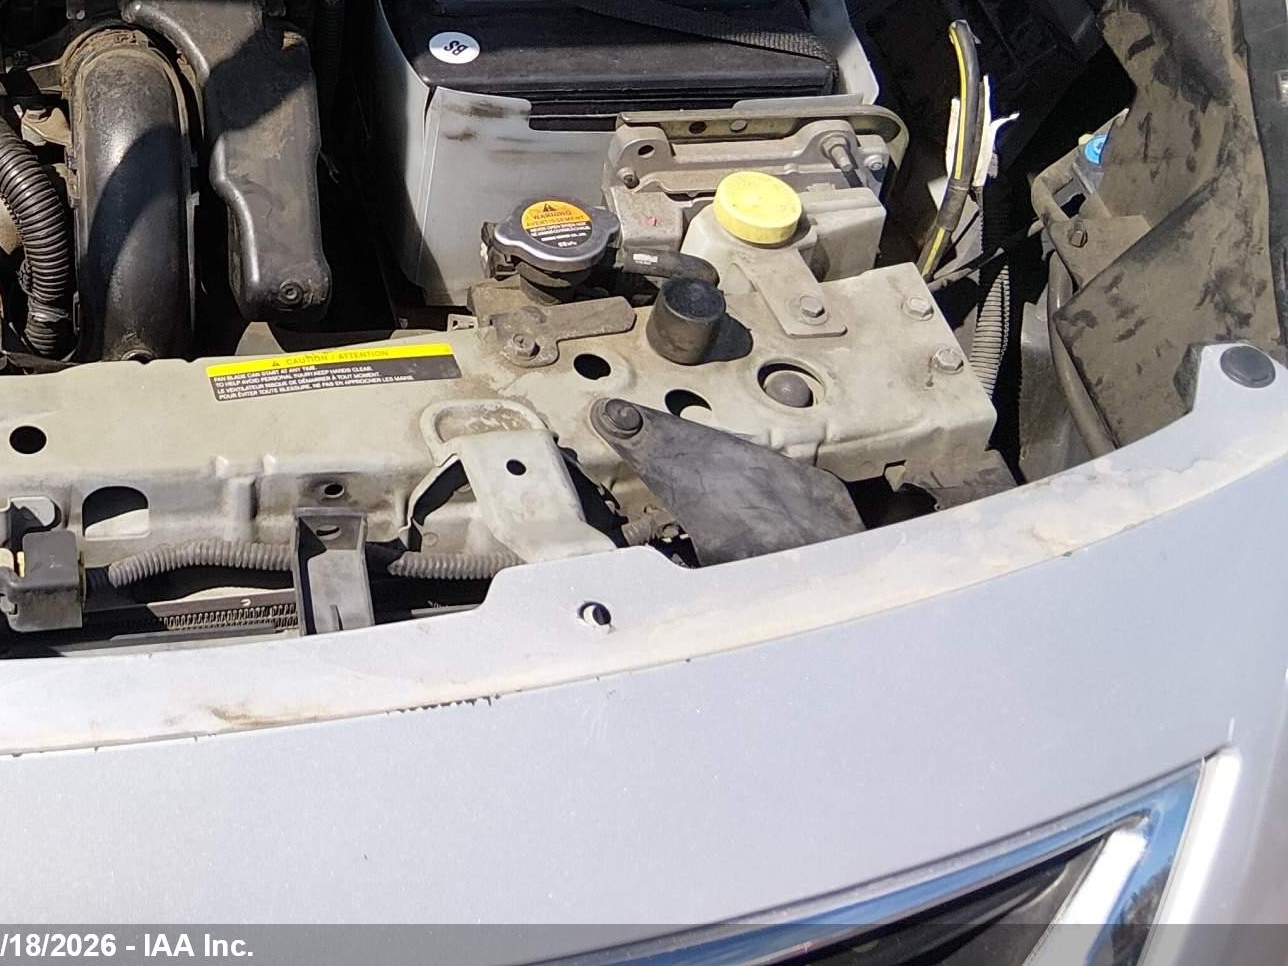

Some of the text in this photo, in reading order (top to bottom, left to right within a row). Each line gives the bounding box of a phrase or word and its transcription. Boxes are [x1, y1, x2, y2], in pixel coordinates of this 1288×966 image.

[444, 40, 468, 56] BS
[533, 210, 572, 220] WARNING
[285, 354, 328, 366] CAUTION
[338, 349, 390, 361] ATTENTION
[247, 371, 261, 379] CAN
